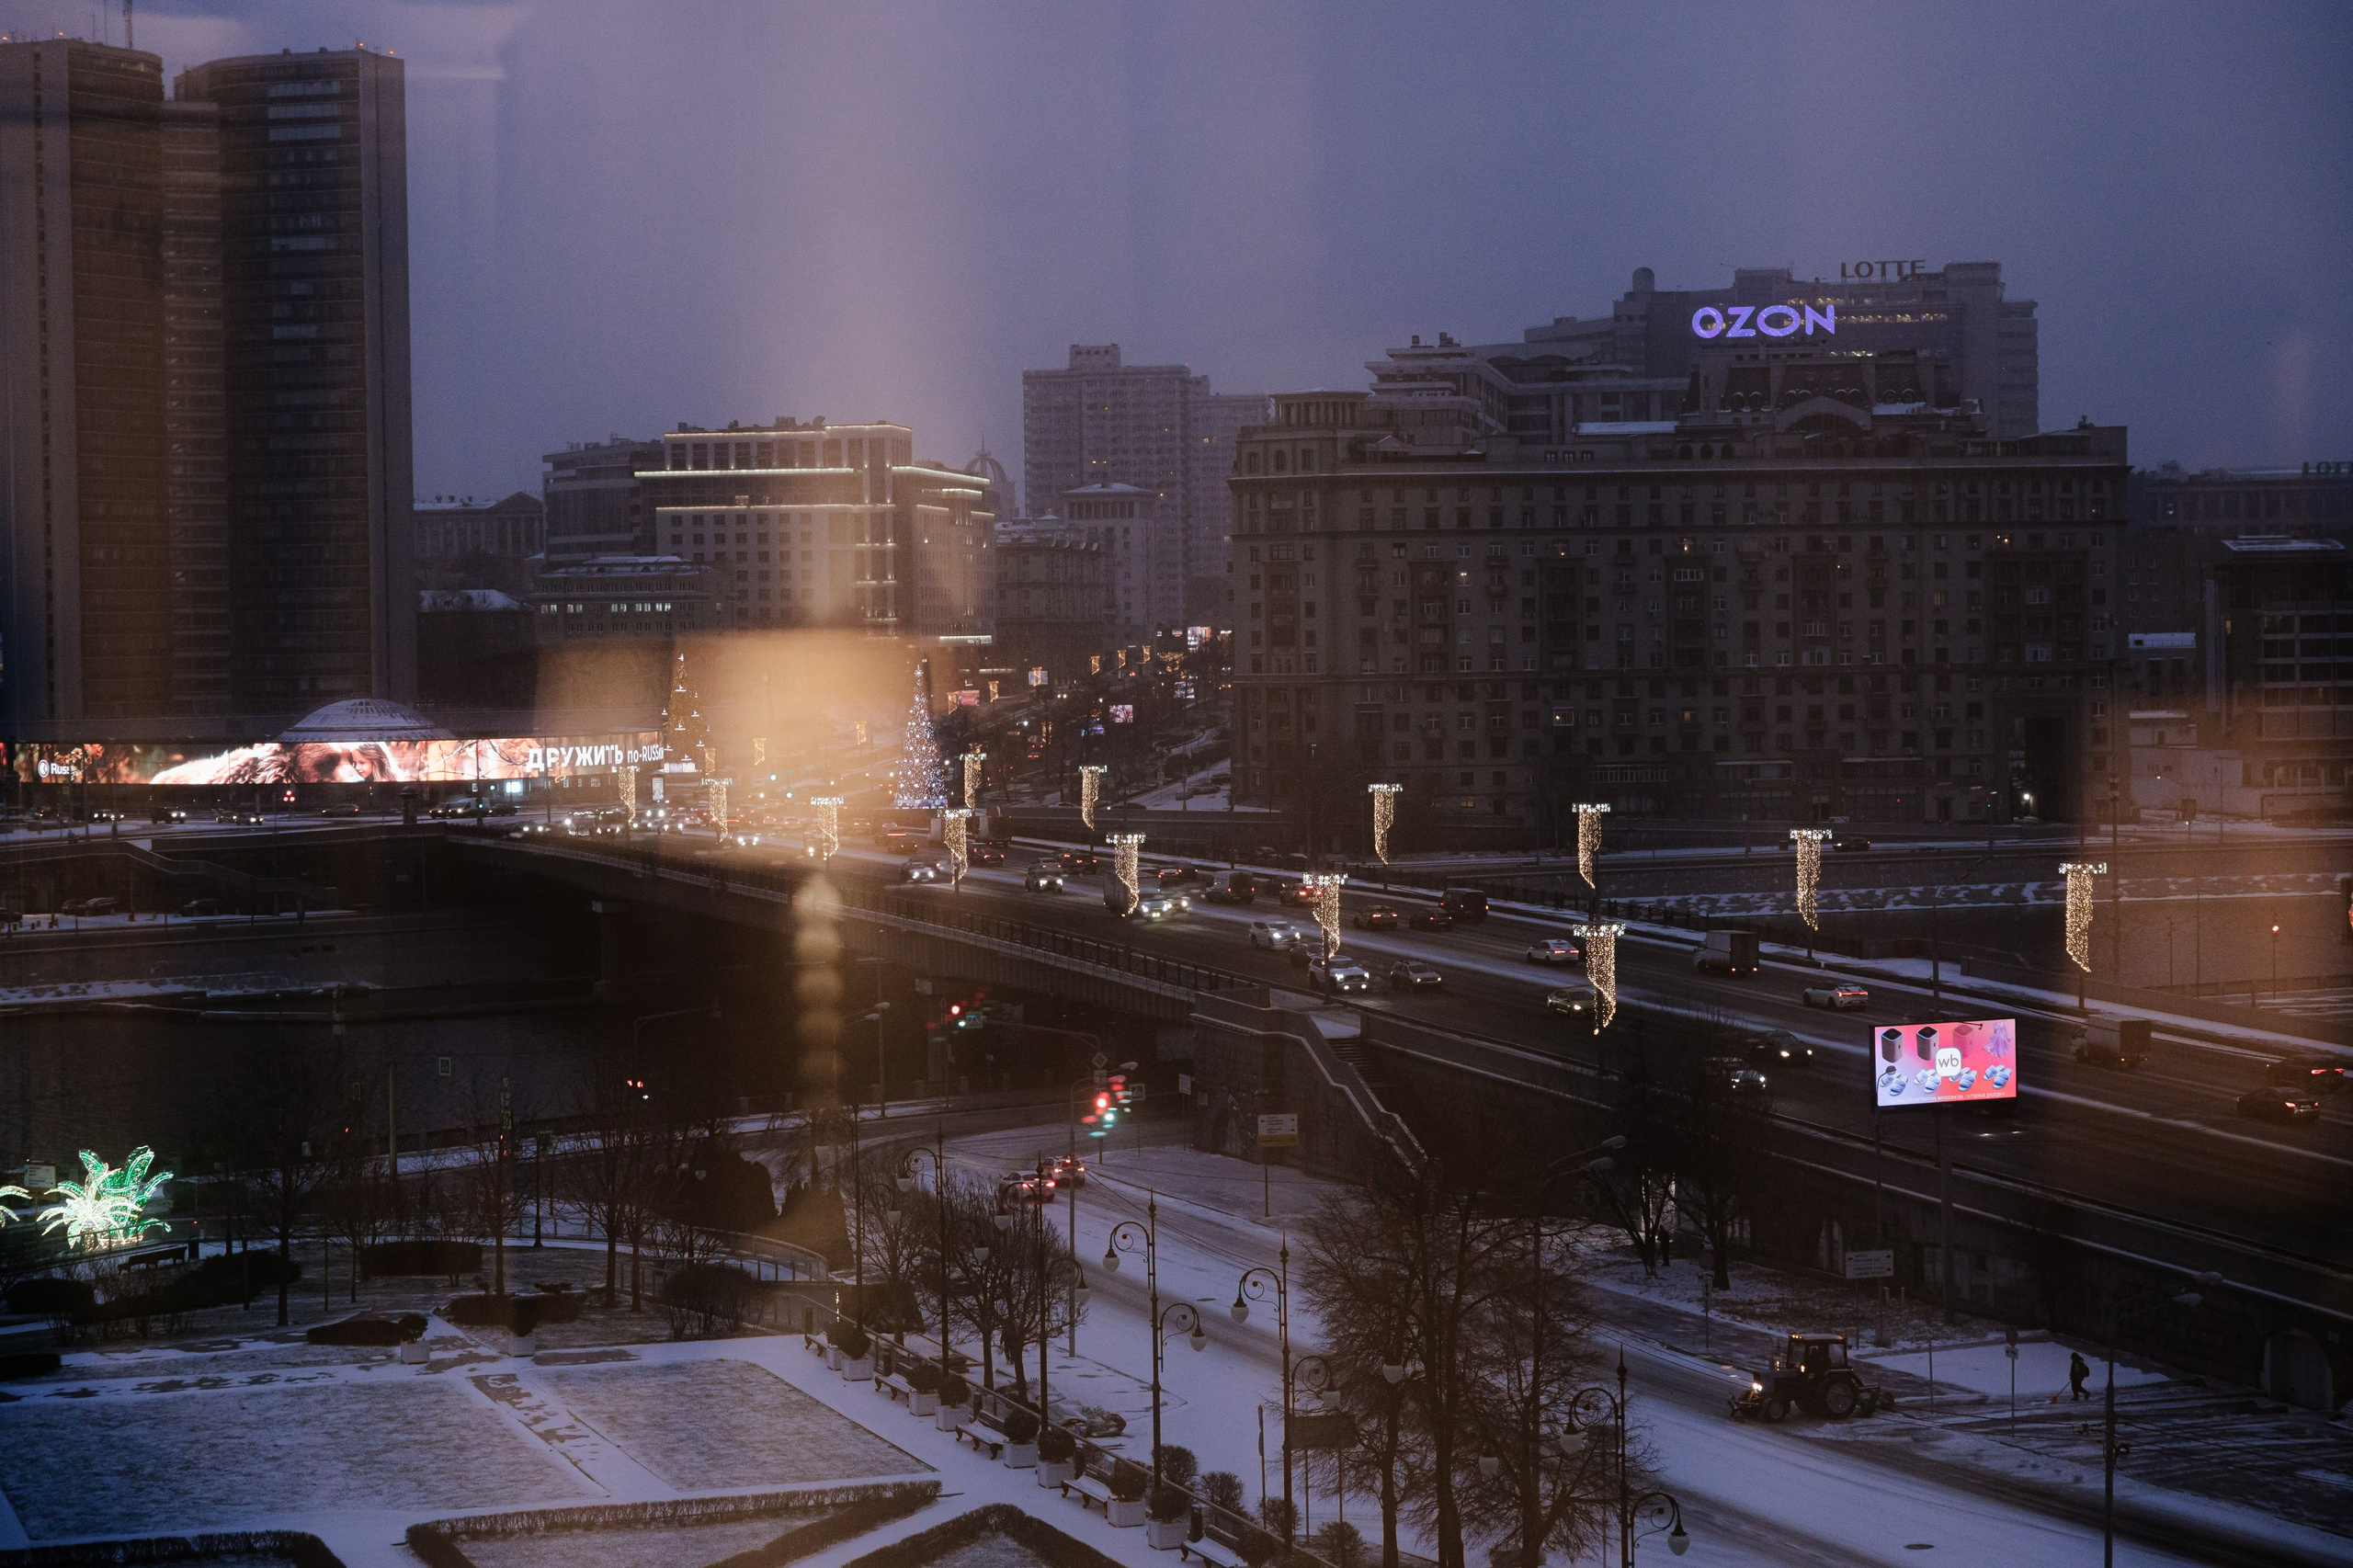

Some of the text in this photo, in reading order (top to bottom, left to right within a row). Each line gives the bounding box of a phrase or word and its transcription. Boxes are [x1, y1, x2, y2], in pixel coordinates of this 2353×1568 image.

[1841, 259, 1926, 278] LOTTE
[1692, 304, 1836, 339] OZON
[526, 744, 624, 773] ДРУЖИТЬ
[1938, 1053, 1960, 1068] wb
